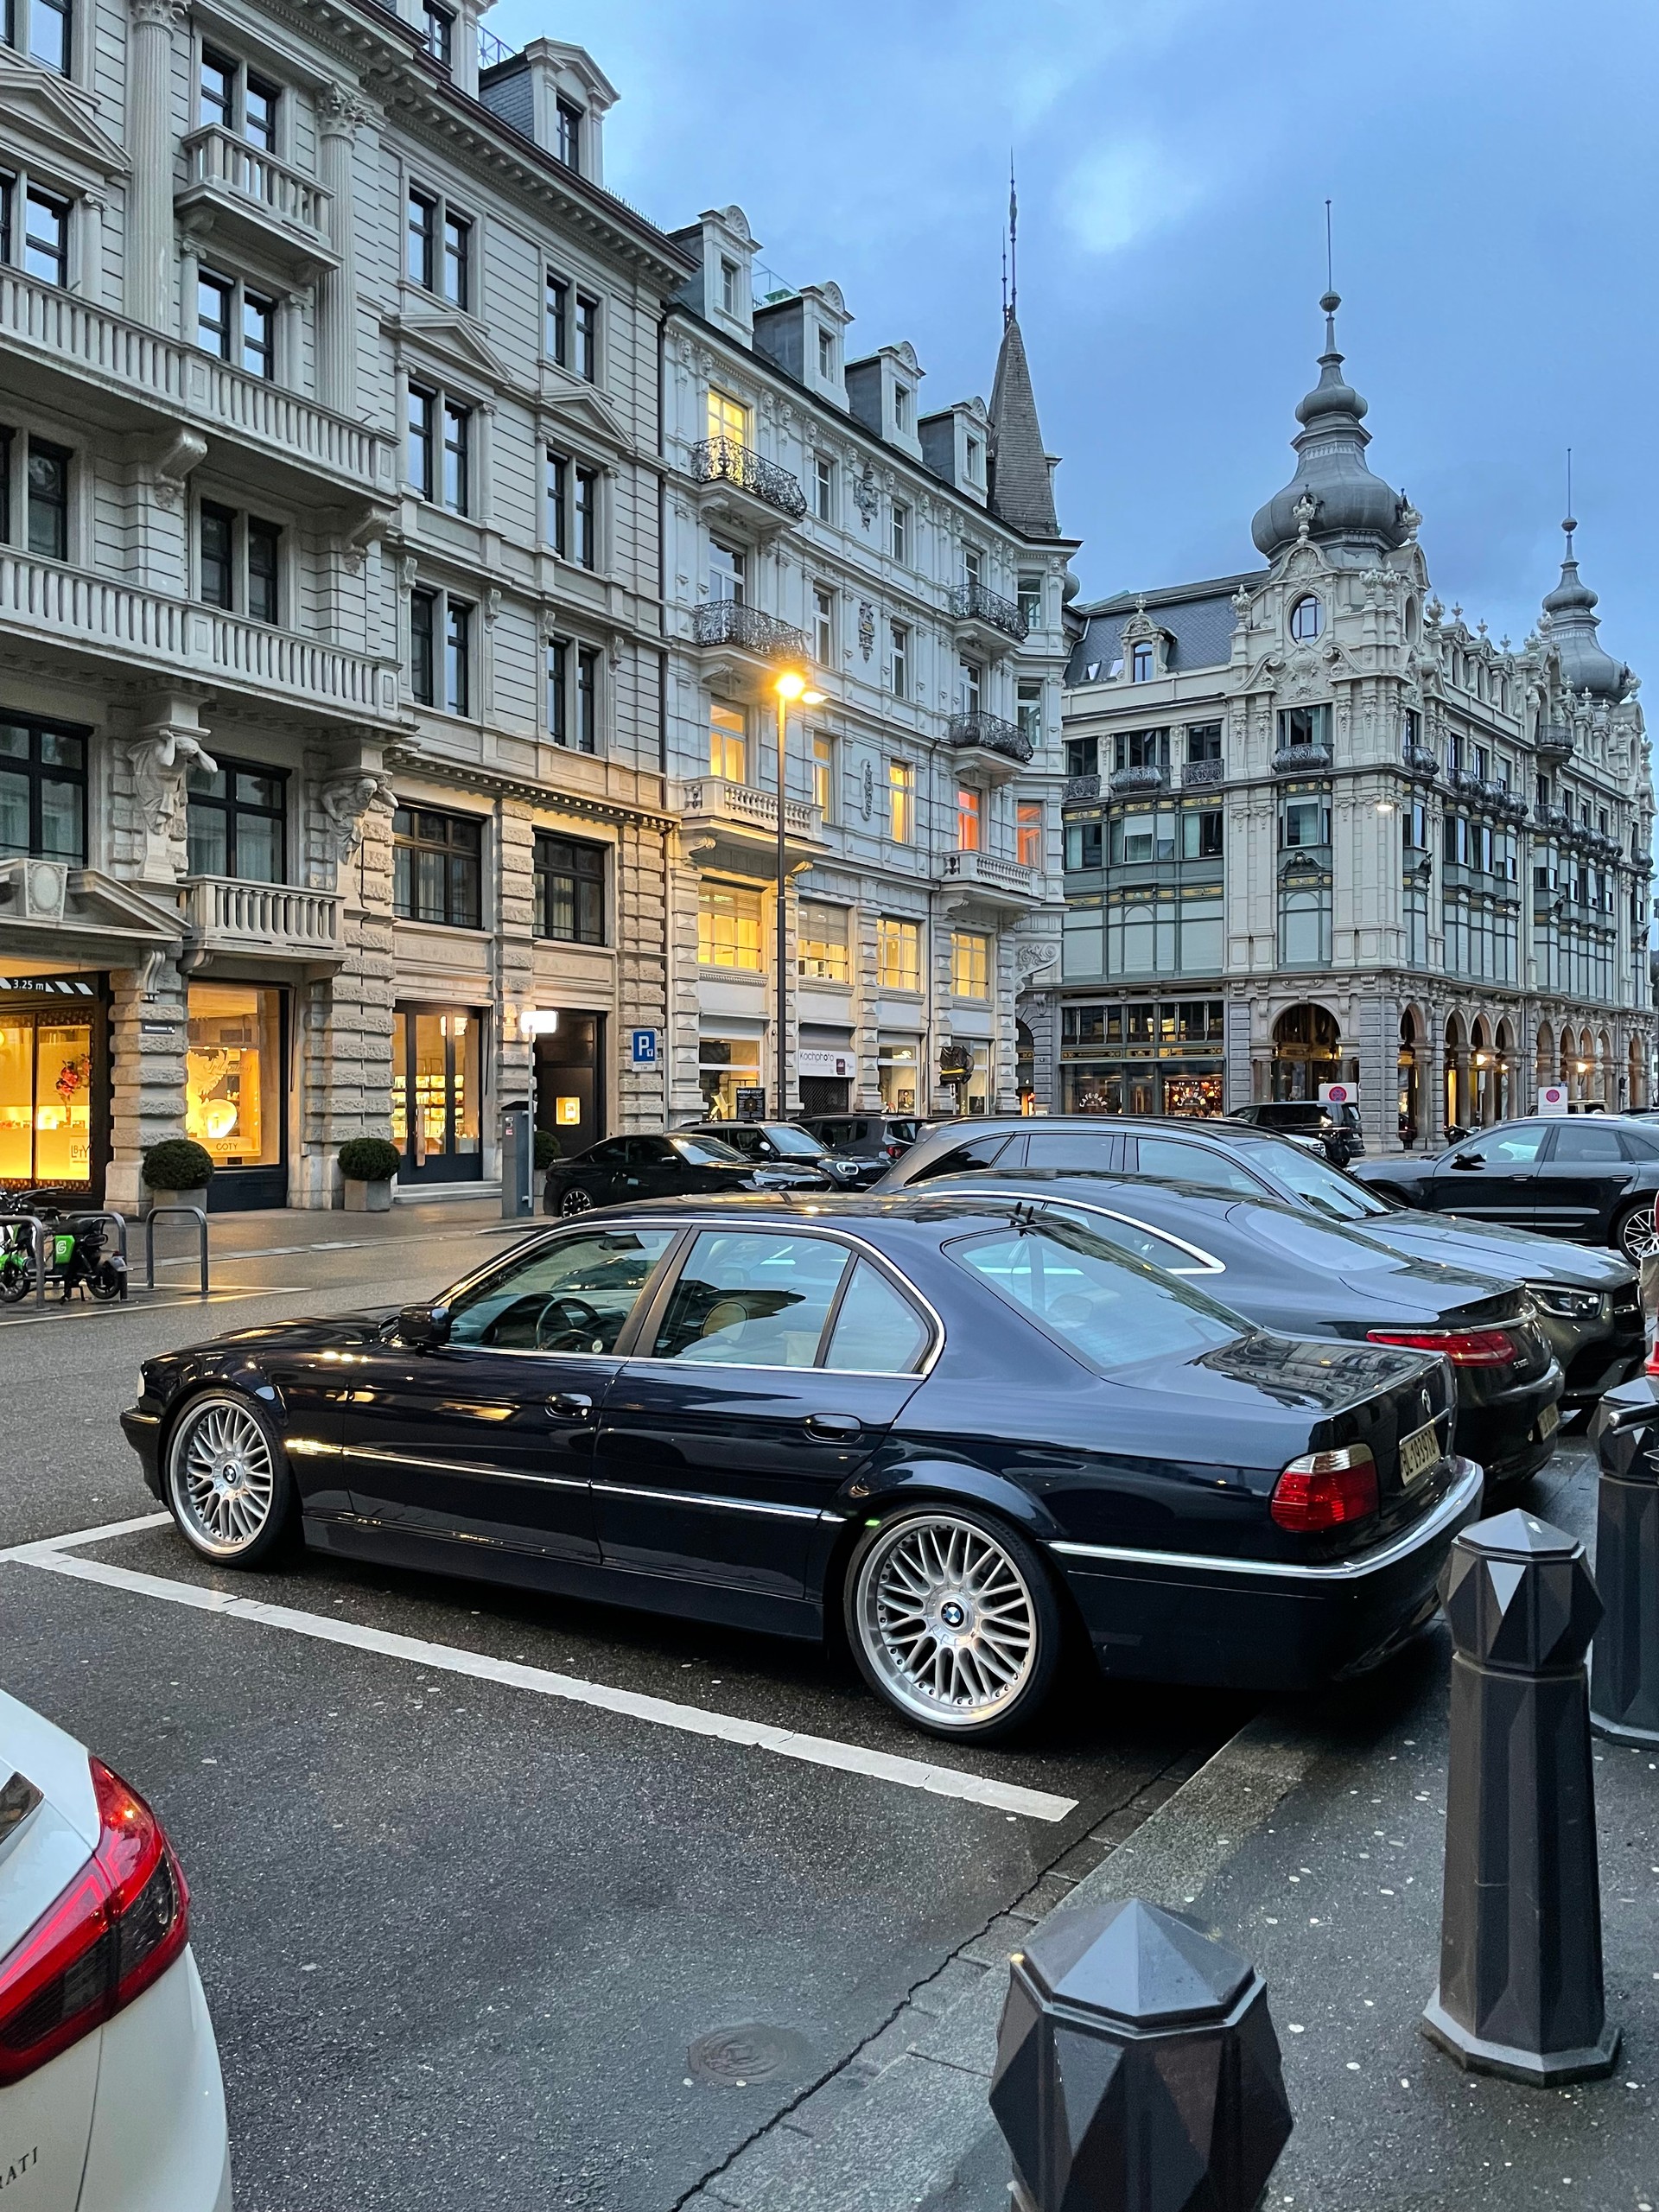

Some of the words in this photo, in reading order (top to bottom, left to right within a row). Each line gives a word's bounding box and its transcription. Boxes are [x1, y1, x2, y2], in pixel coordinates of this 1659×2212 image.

[13, 979, 33, 990] 3.25
[35, 982, 44, 991] m
[639, 1036, 650, 1057] P
[215, 1142, 238, 1151] COTY
